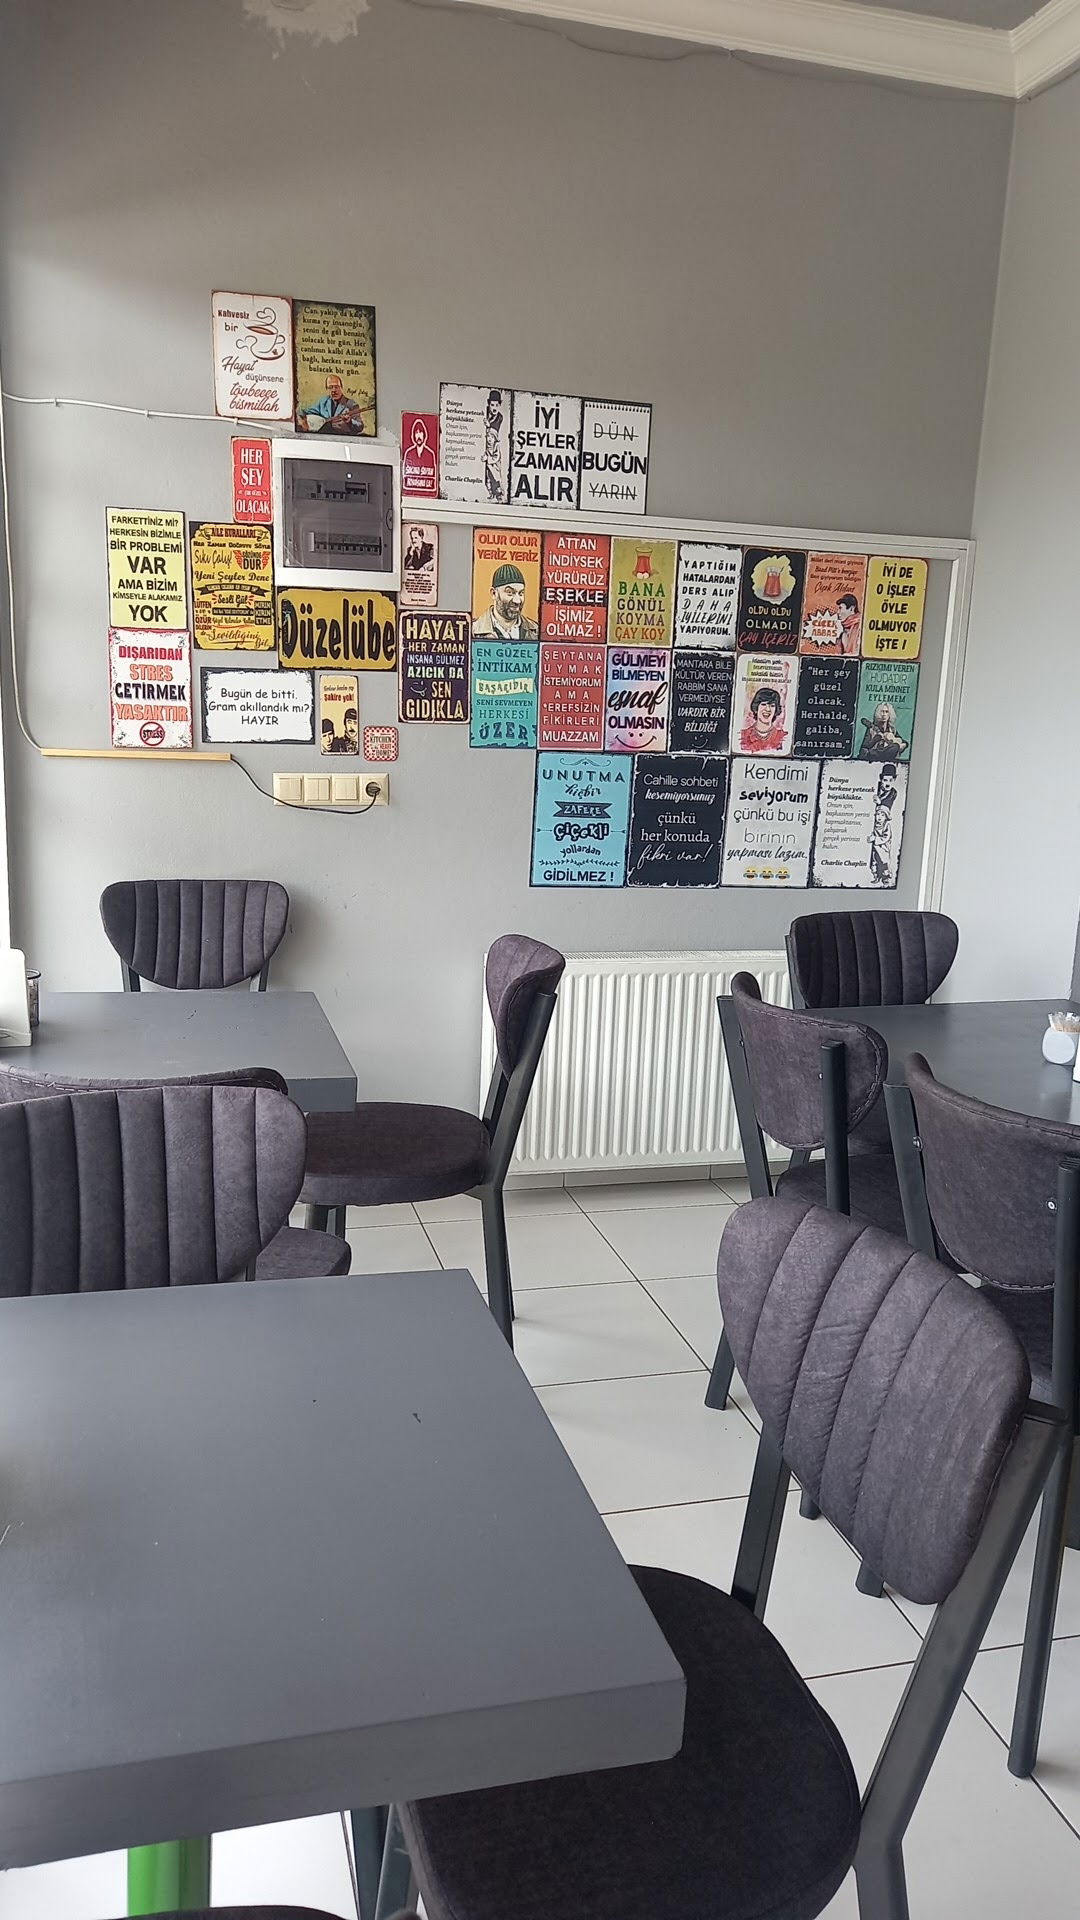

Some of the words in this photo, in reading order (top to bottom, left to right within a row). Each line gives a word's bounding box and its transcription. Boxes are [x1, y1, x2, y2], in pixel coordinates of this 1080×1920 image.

[218, 309, 249, 319] Kahvesiz
[224, 323, 238, 332] bir
[222, 356, 258, 375] Hayat
[335, 366, 344, 374] bir
[246, 373, 284, 383] düşünsene
[229, 398, 279, 412] bismillah
[535, 401, 560, 429] İYİ
[593, 422, 639, 441] DÜN
[517, 431, 575, 451] ŞEYLER
[241, 448, 263, 464] HER
[514, 452, 577, 472] ZAMAN
[583, 452, 647, 475] BUGÜN
[241, 468, 264, 488] ŞEY
[514, 474, 574, 502] ALIR
[588, 483, 637, 501] YARIN
[236, 499, 270, 514] OLACAK
[112, 516, 163, 526] FARKETTİNİZ
[165, 519, 179, 527] Mİ?
[110, 528, 147, 537] HERKESİN
[150, 529, 181, 539] BİZİMLE
[110, 538, 127, 551] BİR
[130, 542, 182, 553] PROBLEMİ
[478, 534, 507, 545] OLUR
[510, 535, 538, 547] OLUR
[557, 538, 596, 550] ATTAN
[477, 548, 507, 560] YERİZ
[511, 550, 538, 562] YERİZ
[549, 551, 603, 569] İNDİYSEK
[127, 556, 166, 575] VAR
[243, 559, 261, 570] DUR
[684, 559, 737, 572] YAPTIĞIM
[883, 563, 897, 577] İYİ
[899, 567, 913, 578] DE
[195, 571, 215, 581] Yeni
[218, 571, 245, 582] Şeyler
[249, 572, 269, 581] Dene
[547, 571, 604, 586] YÜRÜRÜZ
[683, 574, 735, 584] HATALARDAN
[118, 579, 142, 590] AMA
[146, 579, 177, 591] BİZİM
[618, 581, 665, 597] BANA
[682, 586, 707, 596] DERS
[712, 588, 734, 597] ALIP
[877, 585, 883, 594] O
[887, 581, 916, 598] İŞLER
[113, 592, 147, 600] KİMSEYLE
[218, 594, 234, 603] Sesli
[546, 588, 604, 603] EŞEKLE
[617, 599, 665, 612] GÖNÜL
[748, 606, 768, 616] OLDU
[771, 607, 791, 617] OLDU
[882, 599, 908, 614] ÖYLE
[129, 605, 168, 623] YOK
[556, 606, 594, 623] İŞİMİZ
[616, 613, 664, 626] KOYMA
[282, 599, 394, 661] Düzelübe
[406, 618, 466, 641] HAYAT
[547, 623, 593, 637] OLMAZ
[680, 625, 731, 636] YAPIYORUM.
[745, 619, 792, 631] OLMADI
[869, 620, 916, 633] OLMUYOR
[615, 627, 636, 641] ÇAY
[641, 629, 665, 640] KOY
[408, 642, 427, 652] HER
[431, 643, 465, 653] ZAMAN
[876, 637, 899, 651] İŞTE
[119, 646, 183, 661] DIŞARIDAN
[407, 654, 433, 664] İNSANA
[436, 654, 465, 665] GÜLMEZ
[477, 648, 492, 657] EN
[496, 648, 533, 658] GÜZEL
[544, 651, 602, 661] ŞEYTANA
[478, 659, 532, 674] İNTİKAM
[612, 652, 666, 668] GÜLMEYİ
[677, 659, 713, 670] MANTARA
[716, 660, 732, 670] BİLE
[130, 664, 173, 681] STRES
[407, 666, 445, 678] AZICIK
[449, 667, 464, 679] DA
[612, 667, 665, 682] BİLMEYEN
[834, 668, 851, 679] şey
[894, 664, 915, 672] VEREN
[543, 675, 601, 687] İSTEMİYORUM
[675, 670, 704, 681] KÜLTÜR
[707, 671, 732, 681] VEREN
[115, 682, 186, 701] GETİRMEK
[221, 688, 252, 699] Bugün
[255, 690, 268, 698] de
[271, 690, 297, 699] bitti.
[432, 681, 452, 698] SEN
[678, 682, 705, 691] RABBİM
[707, 683, 728, 692] SANA
[813, 683, 842, 692] güzel
[477, 698, 493, 706] SENİ
[495, 699, 533, 707] SEVMEYEN
[608, 681, 669, 714] esnaf
[678, 693, 726, 704] VERMEDİYSE
[808, 697, 845, 706] olacak.
[869, 694, 906, 703] EYLEMEM
[115, 704, 188, 722] YASAKTIR
[208, 702, 238, 711] Gram
[240, 702, 289, 713] akıllandık
[292, 704, 310, 713] mı?
[406, 699, 464, 719] GIDIKLA
[711, 705, 726, 718] BİR
[241, 716, 279, 725] HAYIR
[479, 710, 529, 719] HERKESİ
[544, 714, 599, 726] FİKİRLERİ
[801, 710, 850, 721] Herhalde,
[608, 716, 665, 730] OLMASIN
[684, 720, 718, 733] BİLDİĞİ
[479, 722, 528, 740] ÜZER
[543, 731, 598, 742] MUAZZAM
[806, 726, 843, 736] galiba,
[543, 769, 625, 783] UNUTMA
[745, 764, 808, 781] Kendimi
[644, 774, 678, 786] Cahille
[680, 776, 719, 787] sohbeti
[565, 784, 602, 799] hiçbir
[739, 787, 808, 805] seviyorum
[564, 805, 602, 816] ZAFERE
[734, 808, 774, 823] çünkü
[778, 808, 793, 821] bu
[797, 810, 811, 825] işi
[657, 812, 696, 827] çünkü
[640, 829, 662, 842] her
[664, 831, 710, 842] konuda
[560, 844, 601, 857] yollardan
[638, 844, 674, 869] fikri
[677, 844, 713, 862] var!
[726, 847, 774, 861] yapması
[775, 846, 808, 861] lazım.
[543, 868, 607, 882] GİDİLMEZ
